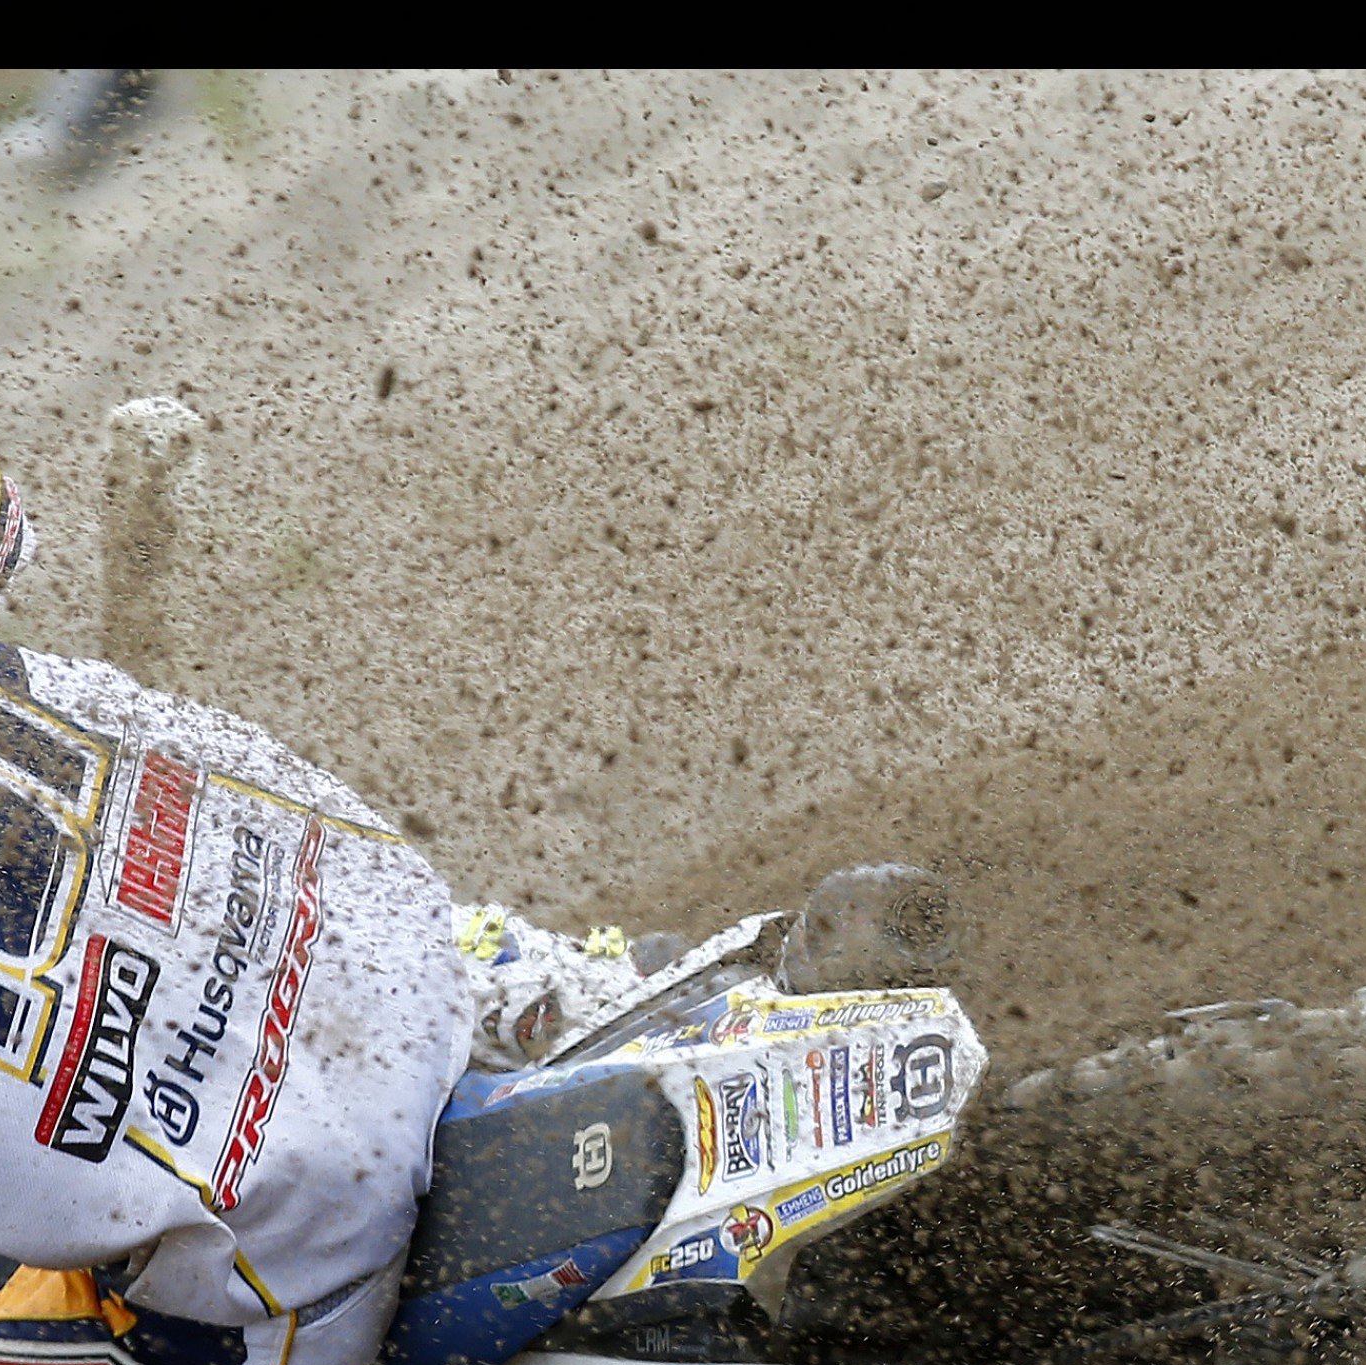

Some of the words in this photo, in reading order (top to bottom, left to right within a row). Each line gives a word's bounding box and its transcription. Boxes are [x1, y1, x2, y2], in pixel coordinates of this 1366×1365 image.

[61, 950, 151, 1145] WILVO
[166, 825, 271, 1084] Husqvarna
[215, 811, 325, 1213] PROGRIP
[825, 1140, 941, 1200] GoldenTyre
